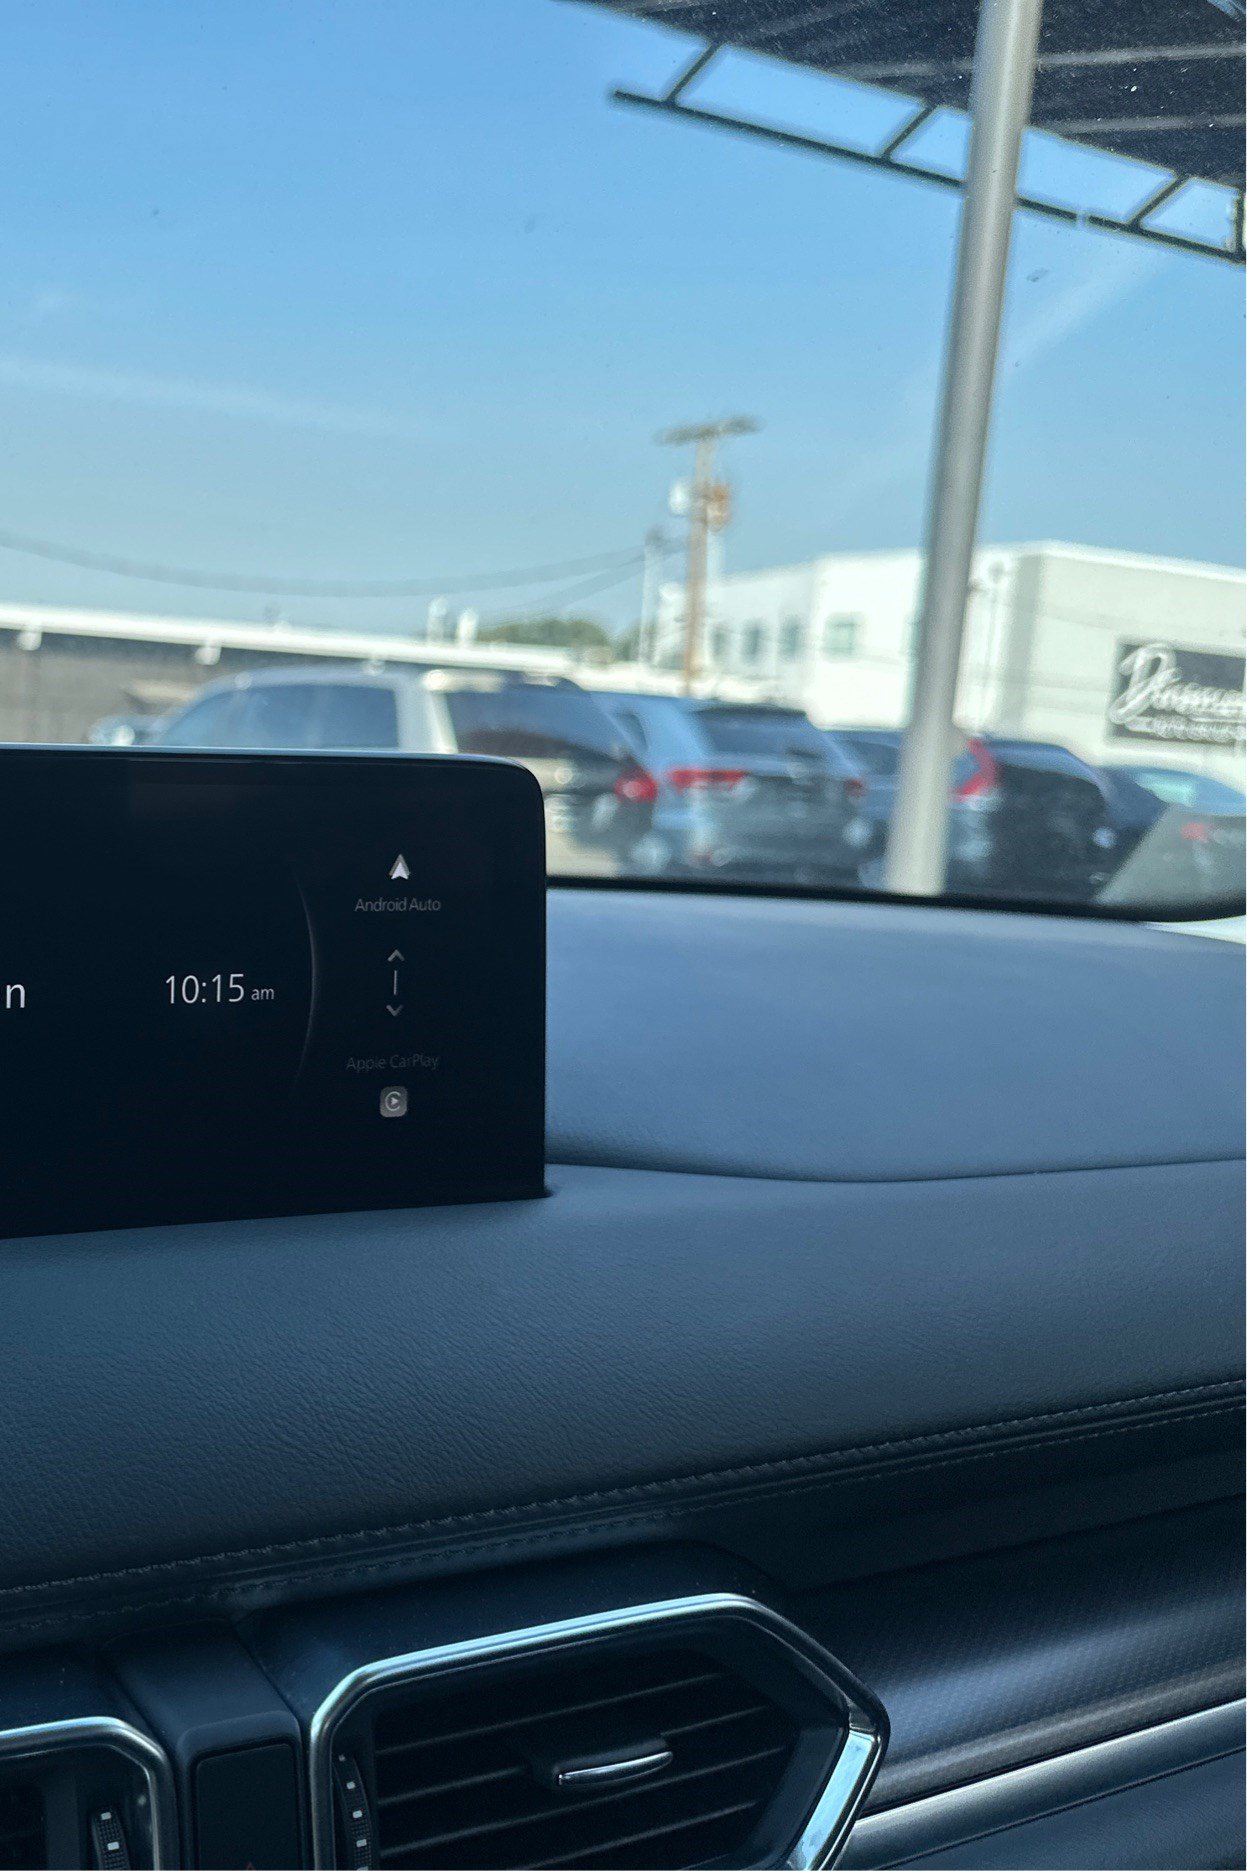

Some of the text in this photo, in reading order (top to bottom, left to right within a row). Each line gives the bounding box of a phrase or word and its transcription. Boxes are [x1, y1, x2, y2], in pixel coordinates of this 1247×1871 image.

[354, 896, 442, 912] Android Auto
[164, 973, 276, 1005] 10:15 am
[346, 1053, 440, 1073] Apple CarPlay
